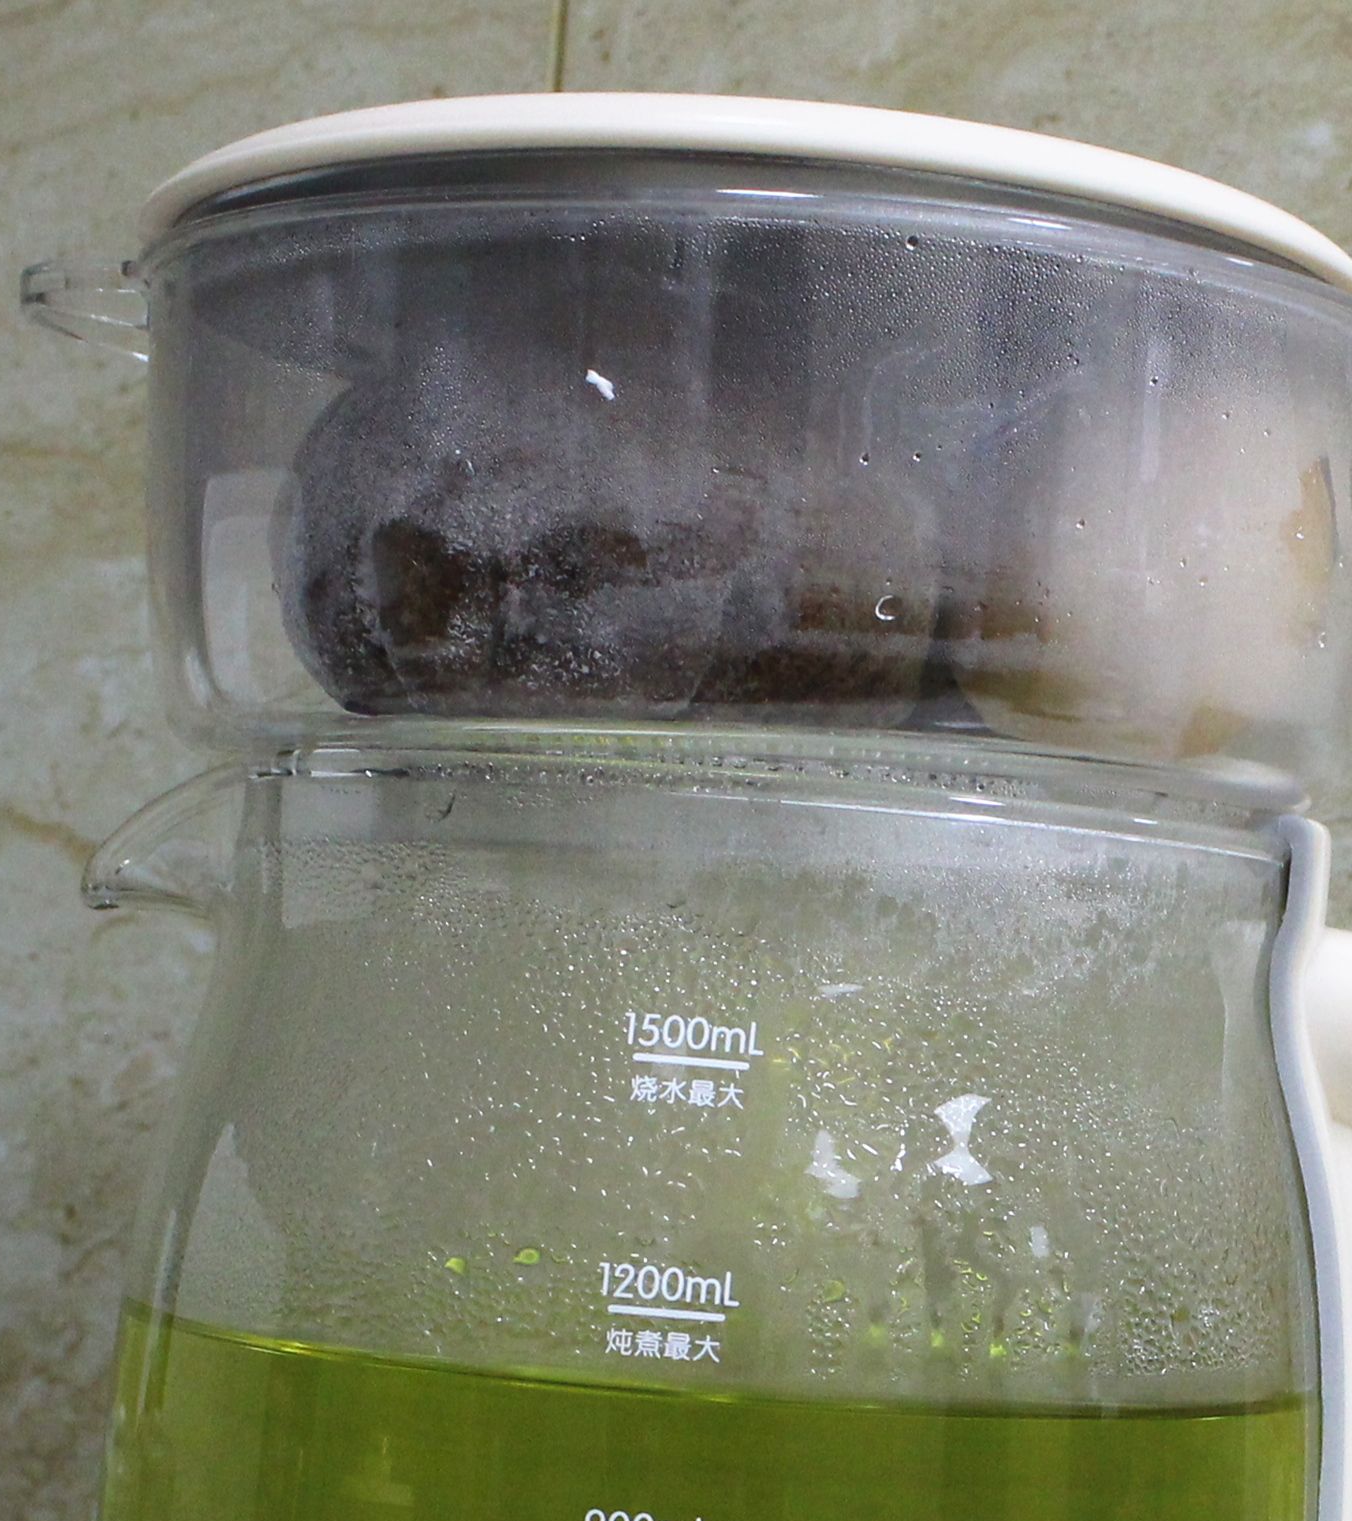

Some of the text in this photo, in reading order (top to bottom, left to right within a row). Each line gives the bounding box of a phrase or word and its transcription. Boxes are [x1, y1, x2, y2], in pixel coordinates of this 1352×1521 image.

[624, 1011, 764, 1056] 1500mL
[631, 1074, 745, 1109] 烧水最大
[599, 1262, 740, 1307] 1200mL
[605, 1328, 721, 1363] 炖煮最大
